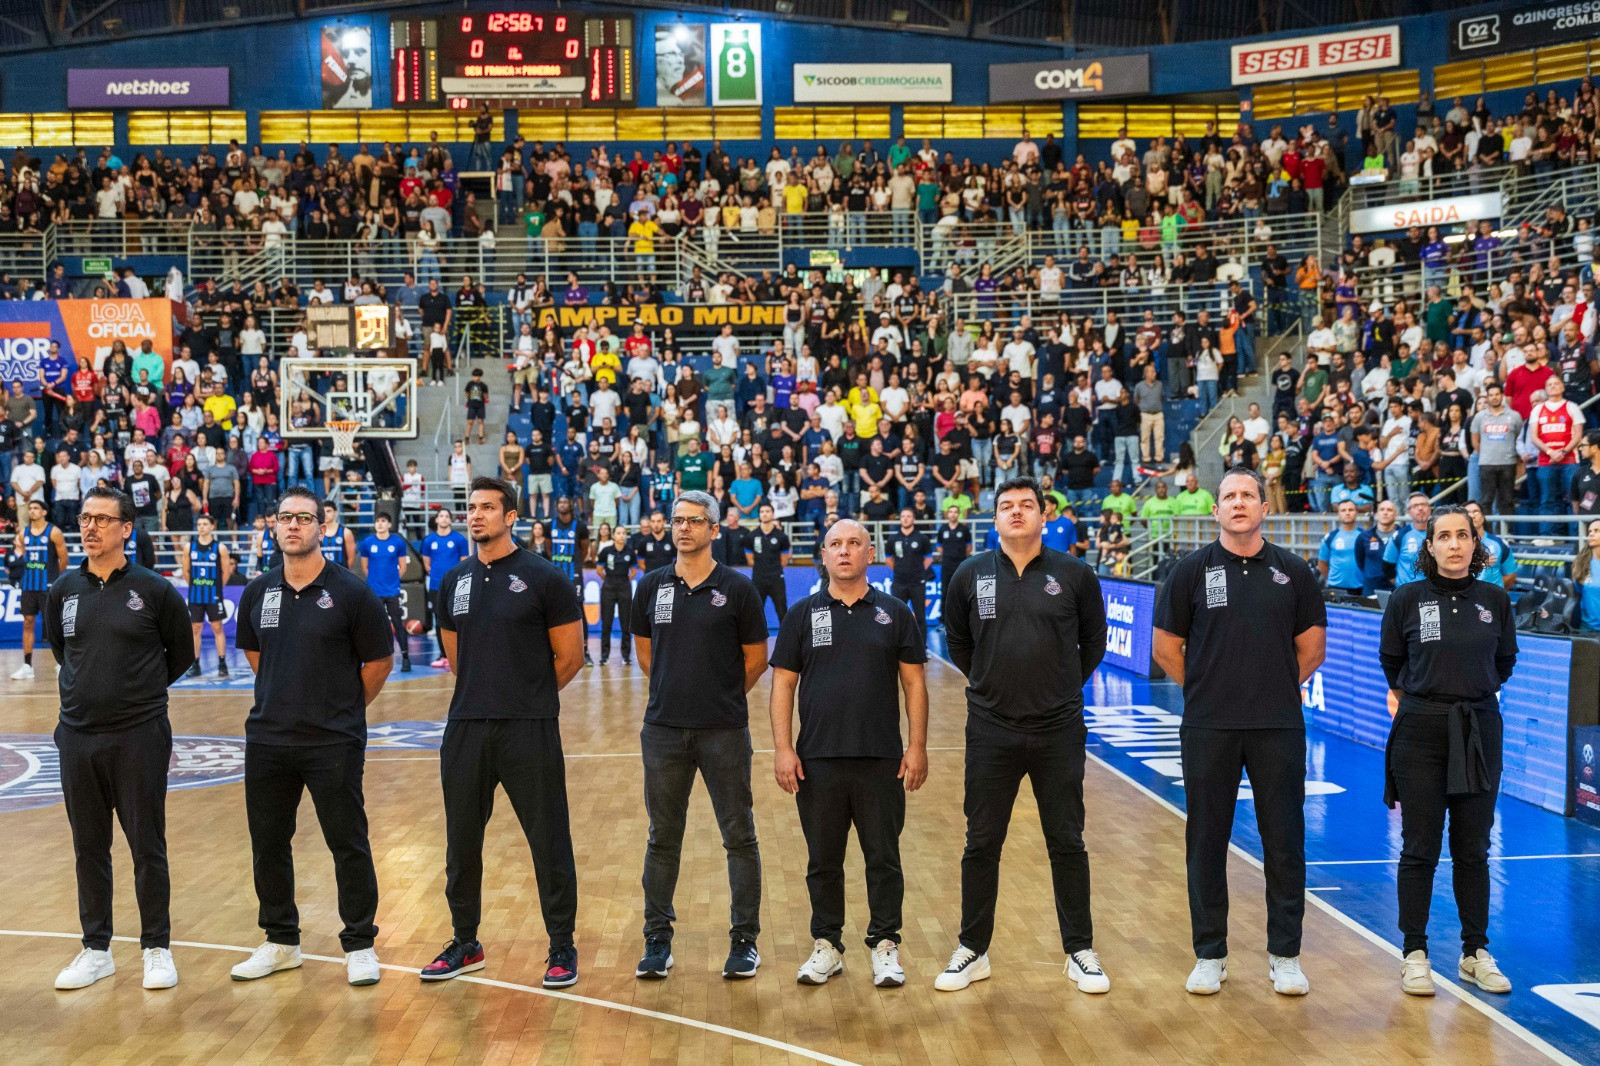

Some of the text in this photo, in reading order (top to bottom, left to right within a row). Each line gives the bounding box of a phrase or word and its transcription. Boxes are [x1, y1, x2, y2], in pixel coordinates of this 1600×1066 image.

[461, 17, 472, 32] 0
[555, 17, 567, 32] 0
[1466, 23, 1489, 38] Q2
[470, 39, 484, 58] 0
[565, 39, 579, 58] 0
[1244, 38, 1385, 73] SESI SESI
[726, 47, 747, 78] 8
[1035, 61, 1103, 92] COM4
[106, 79, 190, 95] netshoes
[91, 303, 145, 322] LOJA
[88, 322, 156, 338] OFICIAL
[0, 338, 50, 361] IOR
[200, 568, 206, 577] 3
